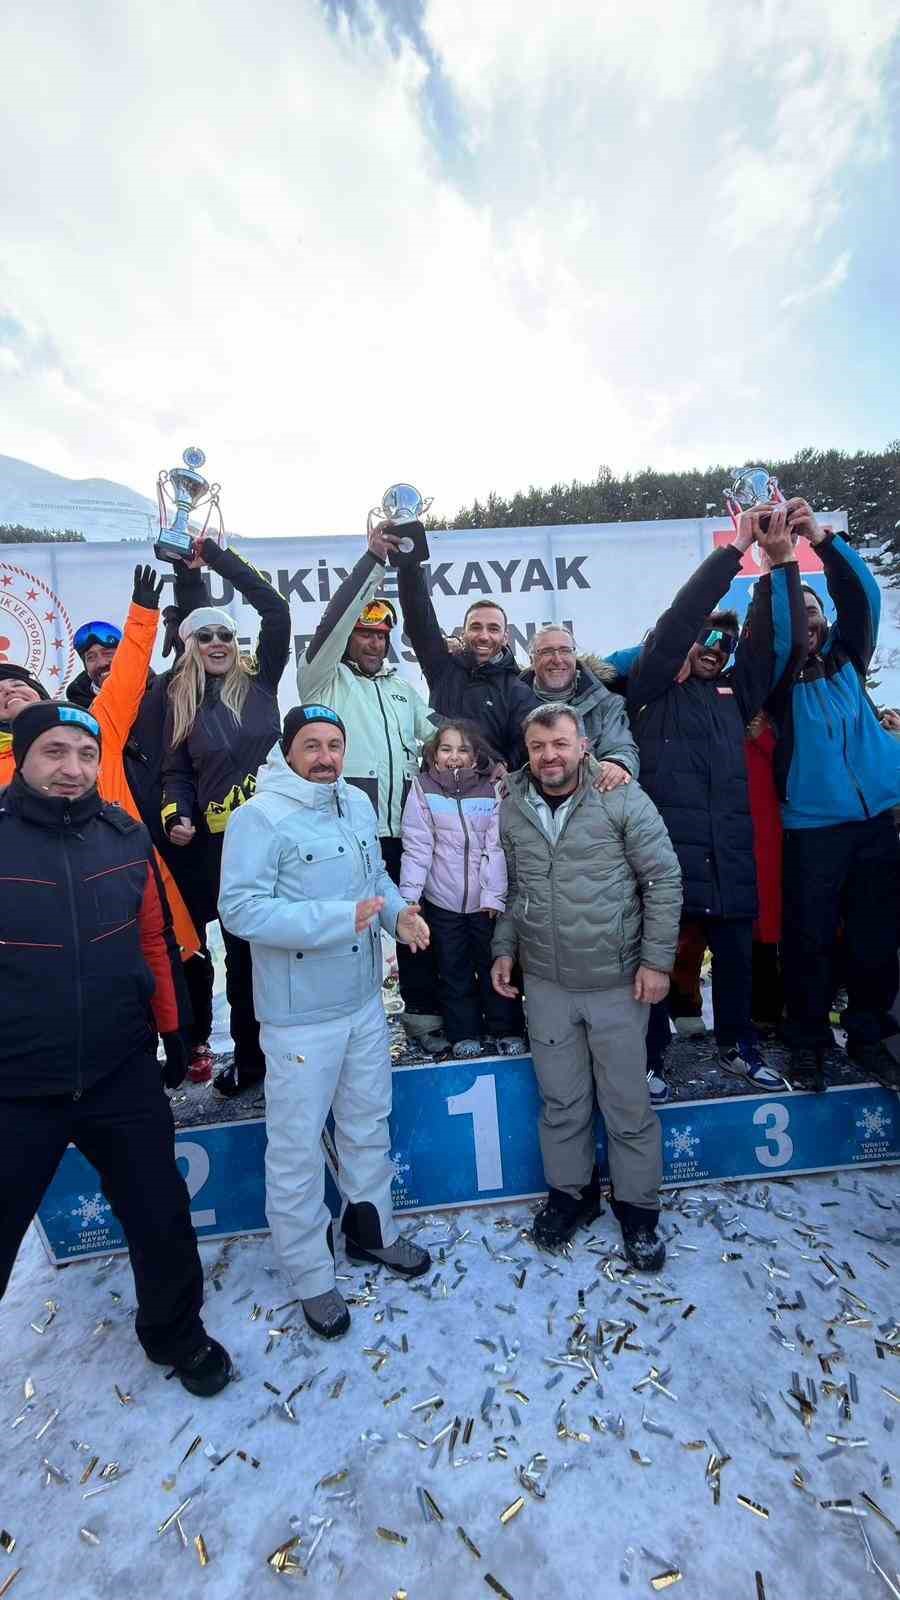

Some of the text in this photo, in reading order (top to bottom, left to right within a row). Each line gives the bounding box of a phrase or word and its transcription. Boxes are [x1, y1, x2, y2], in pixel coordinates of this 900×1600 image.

[421, 556, 591, 596] KAYAK
[13, 604, 26, 618] VE
[24, 617, 41, 646] SPOR
[448, 1074, 503, 1191] 1
[753, 1103, 793, 1168] 3
[174, 1141, 217, 1227] 2
